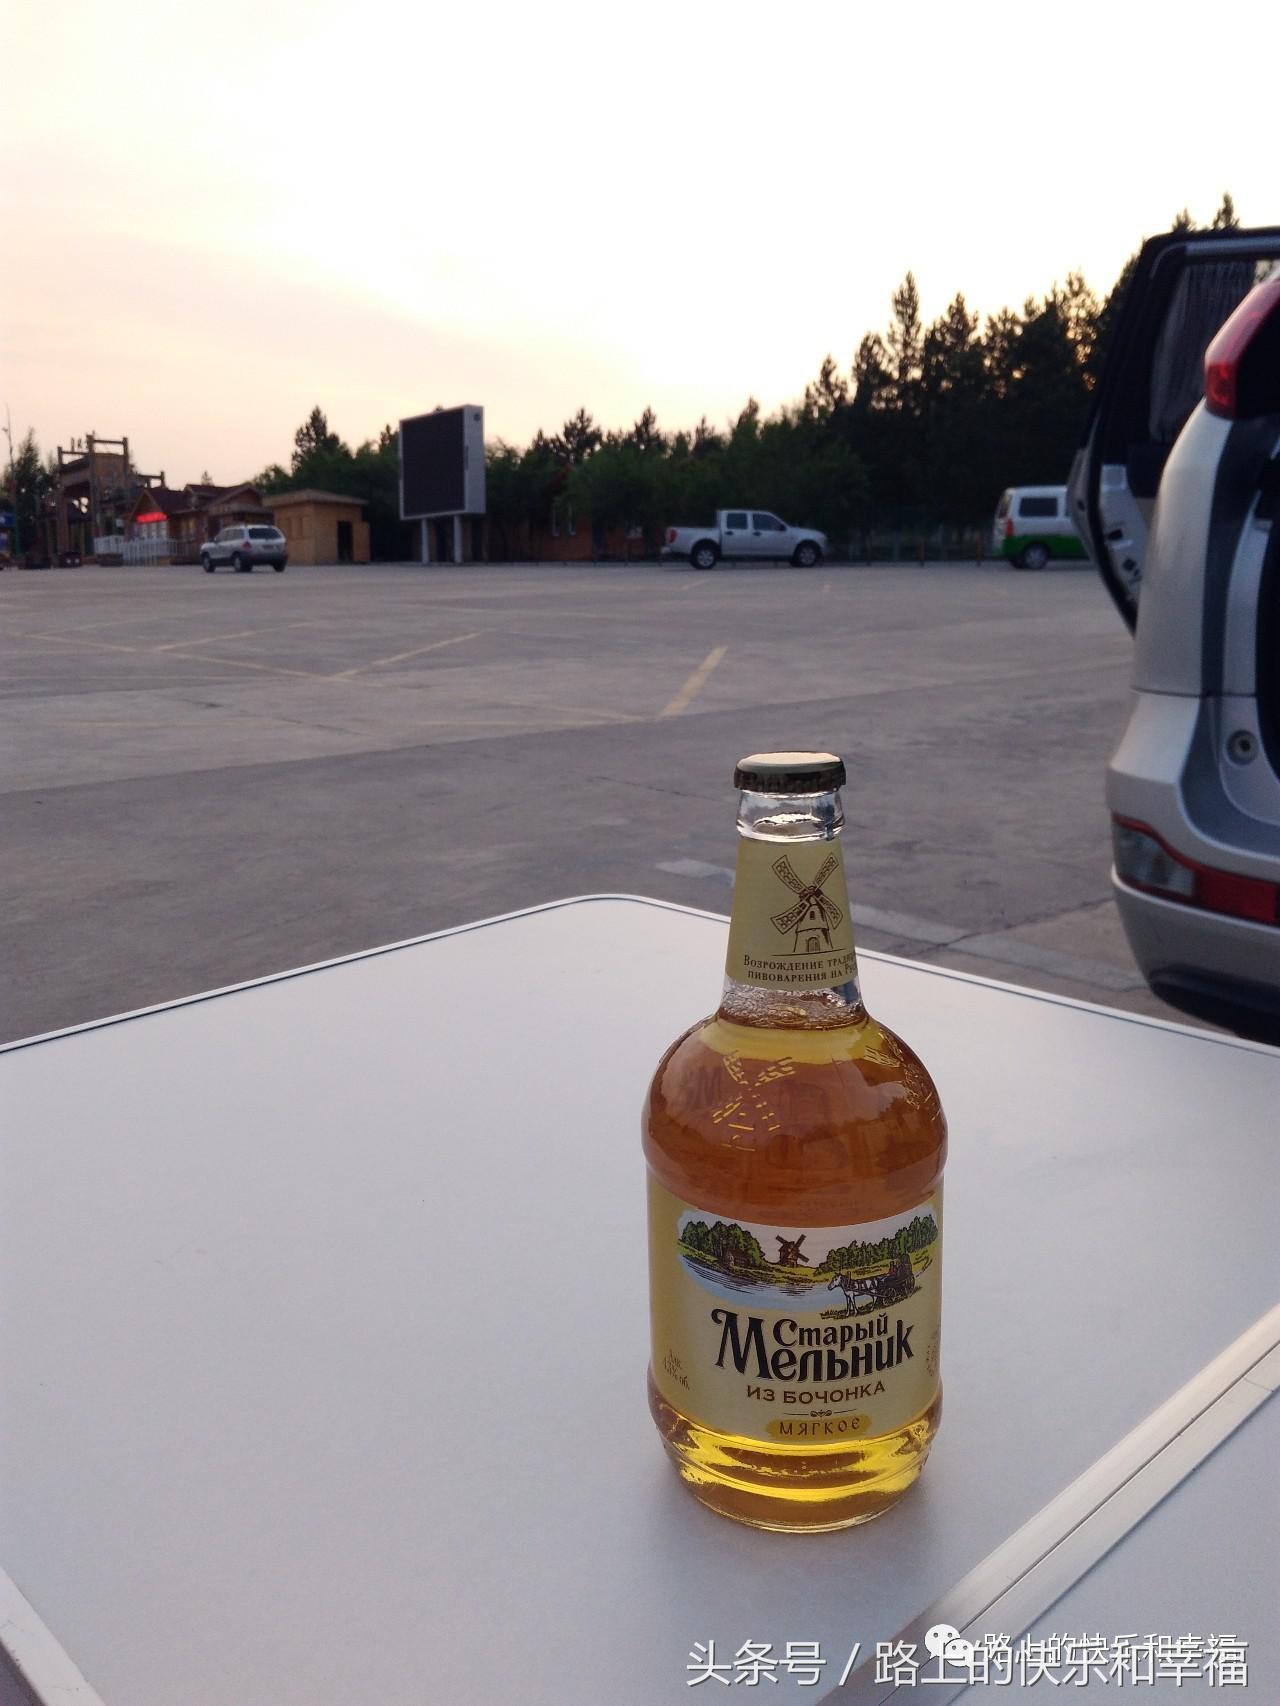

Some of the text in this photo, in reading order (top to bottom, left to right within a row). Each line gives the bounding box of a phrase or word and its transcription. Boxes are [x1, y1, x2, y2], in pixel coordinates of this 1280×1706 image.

[711, 1308, 914, 1383] Мельник
[772, 1313, 889, 1351] Старый
[783, 1380, 886, 1405] БОЧОНКА
